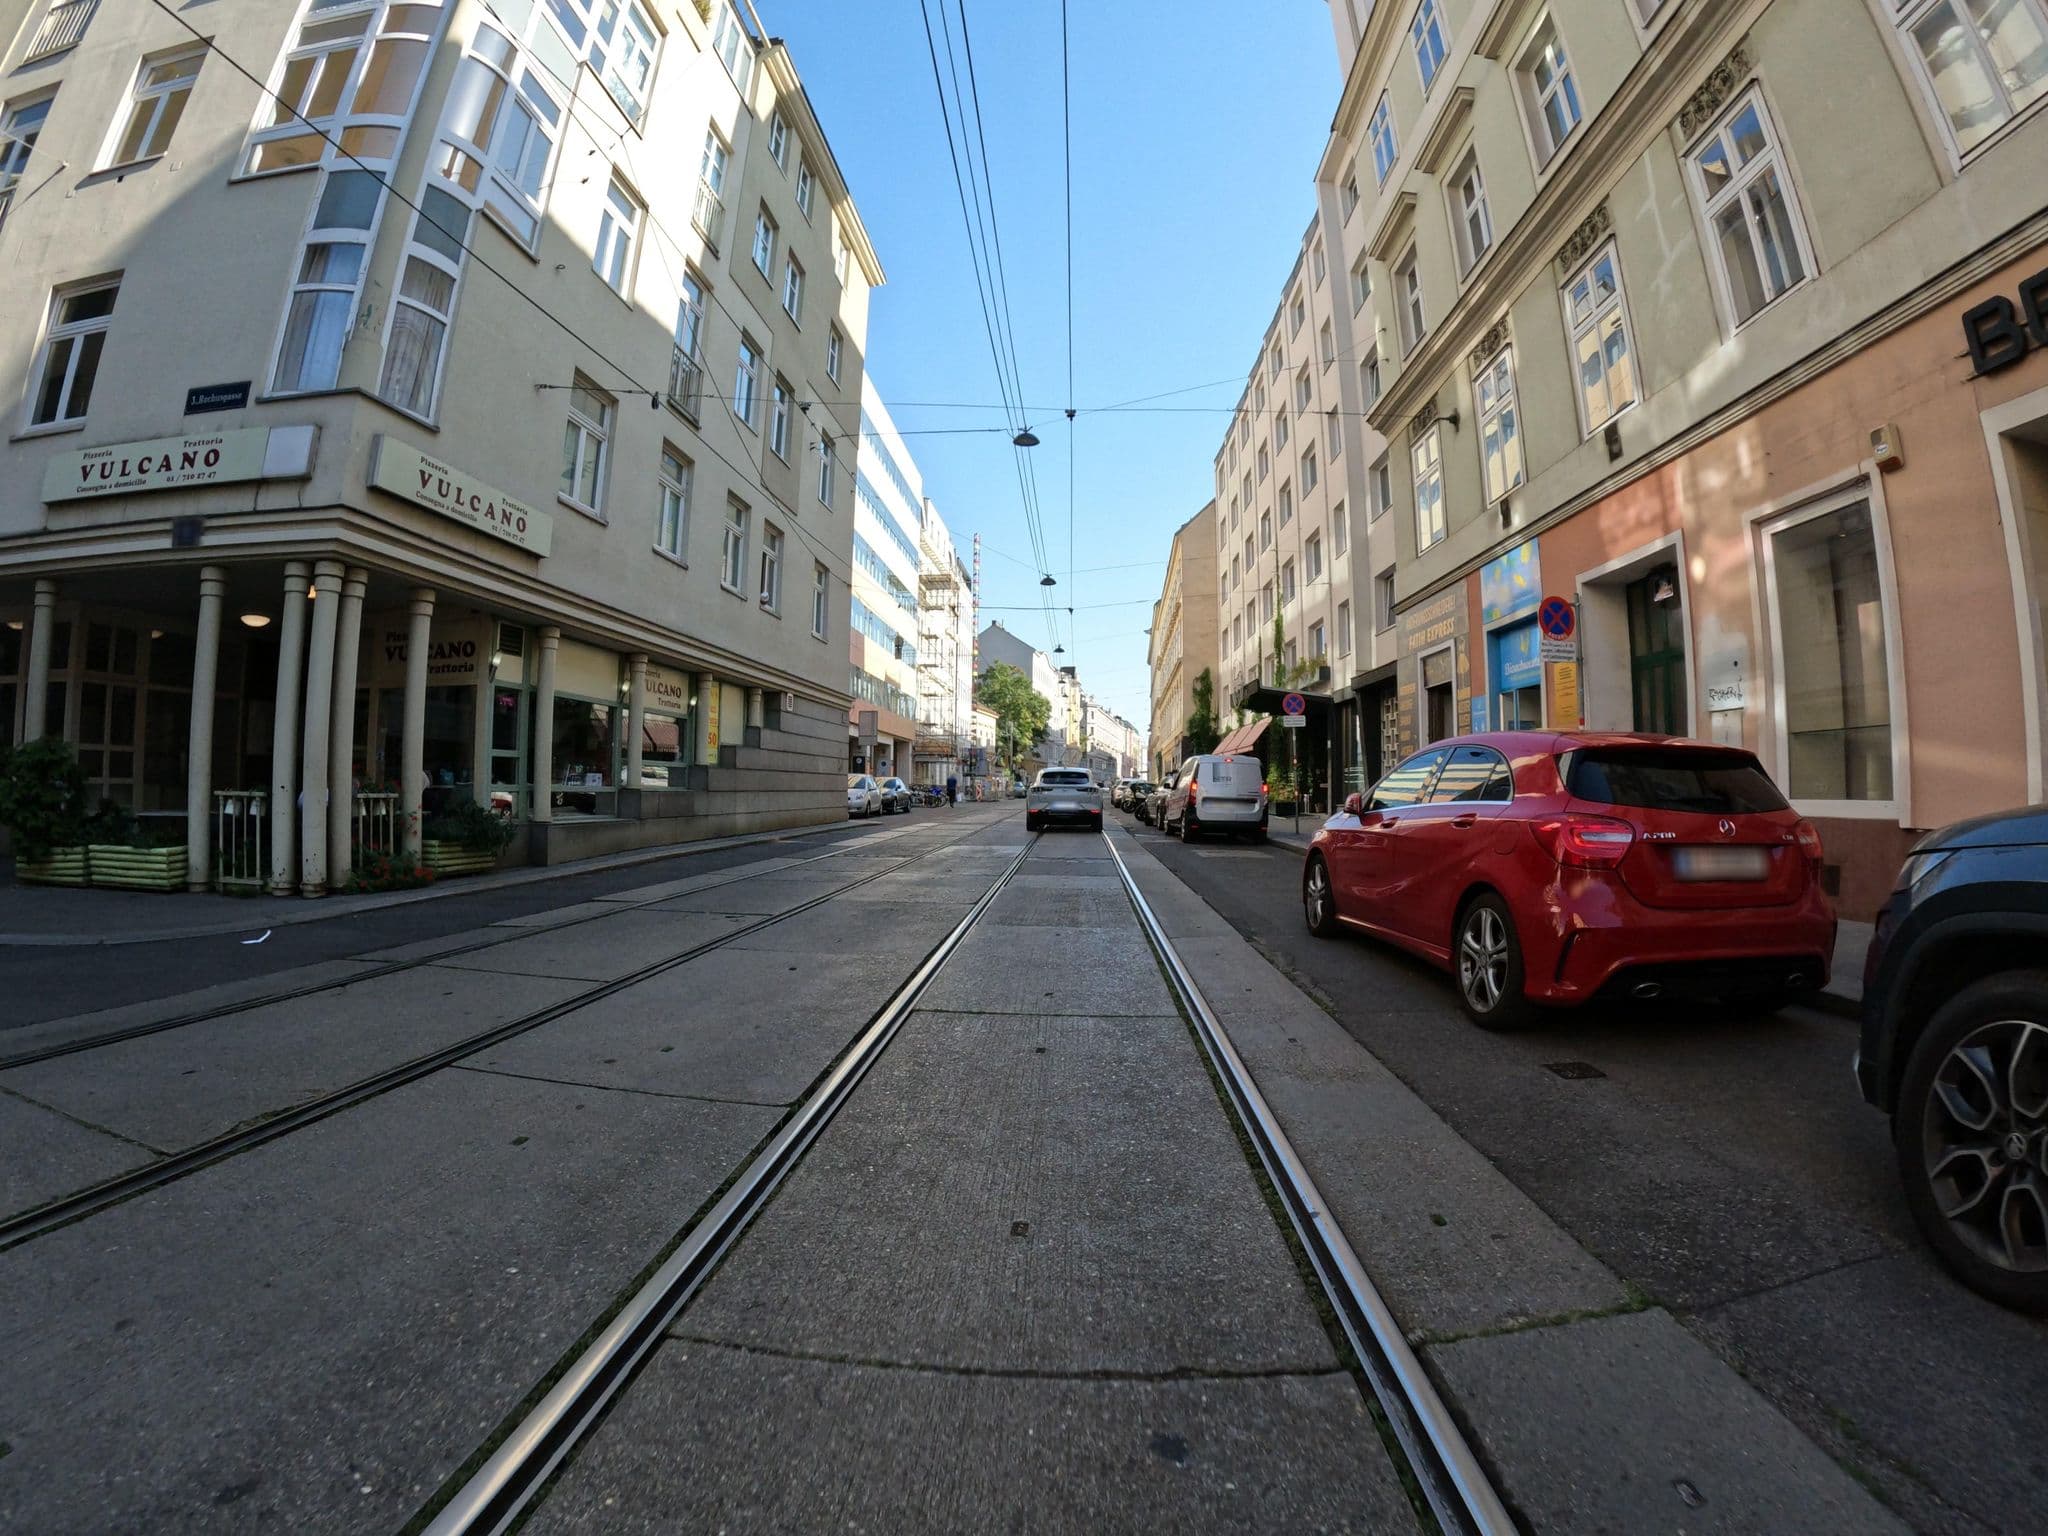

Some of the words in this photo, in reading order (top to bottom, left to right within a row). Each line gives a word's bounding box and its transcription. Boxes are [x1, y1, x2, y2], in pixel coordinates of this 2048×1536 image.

[183, 437, 223, 448] Trattoria
[82, 450, 113, 460] Pizzeria
[80, 448, 220, 482] VULCANO
[420, 456, 448, 475] Pizzeria
[182, 473, 195, 483] 710
[207, 471, 217, 481] 47
[76, 483, 107, 494] Consegna
[415, 490, 445, 510] Consegna
[419, 469, 527, 533] VULCANO
[502, 498, 528, 516] Trattoria
[1427, 616, 1455, 643] EXPRESS
[646, 680, 682, 698] ULCANO
[658, 697, 681, 709] Trattoria
